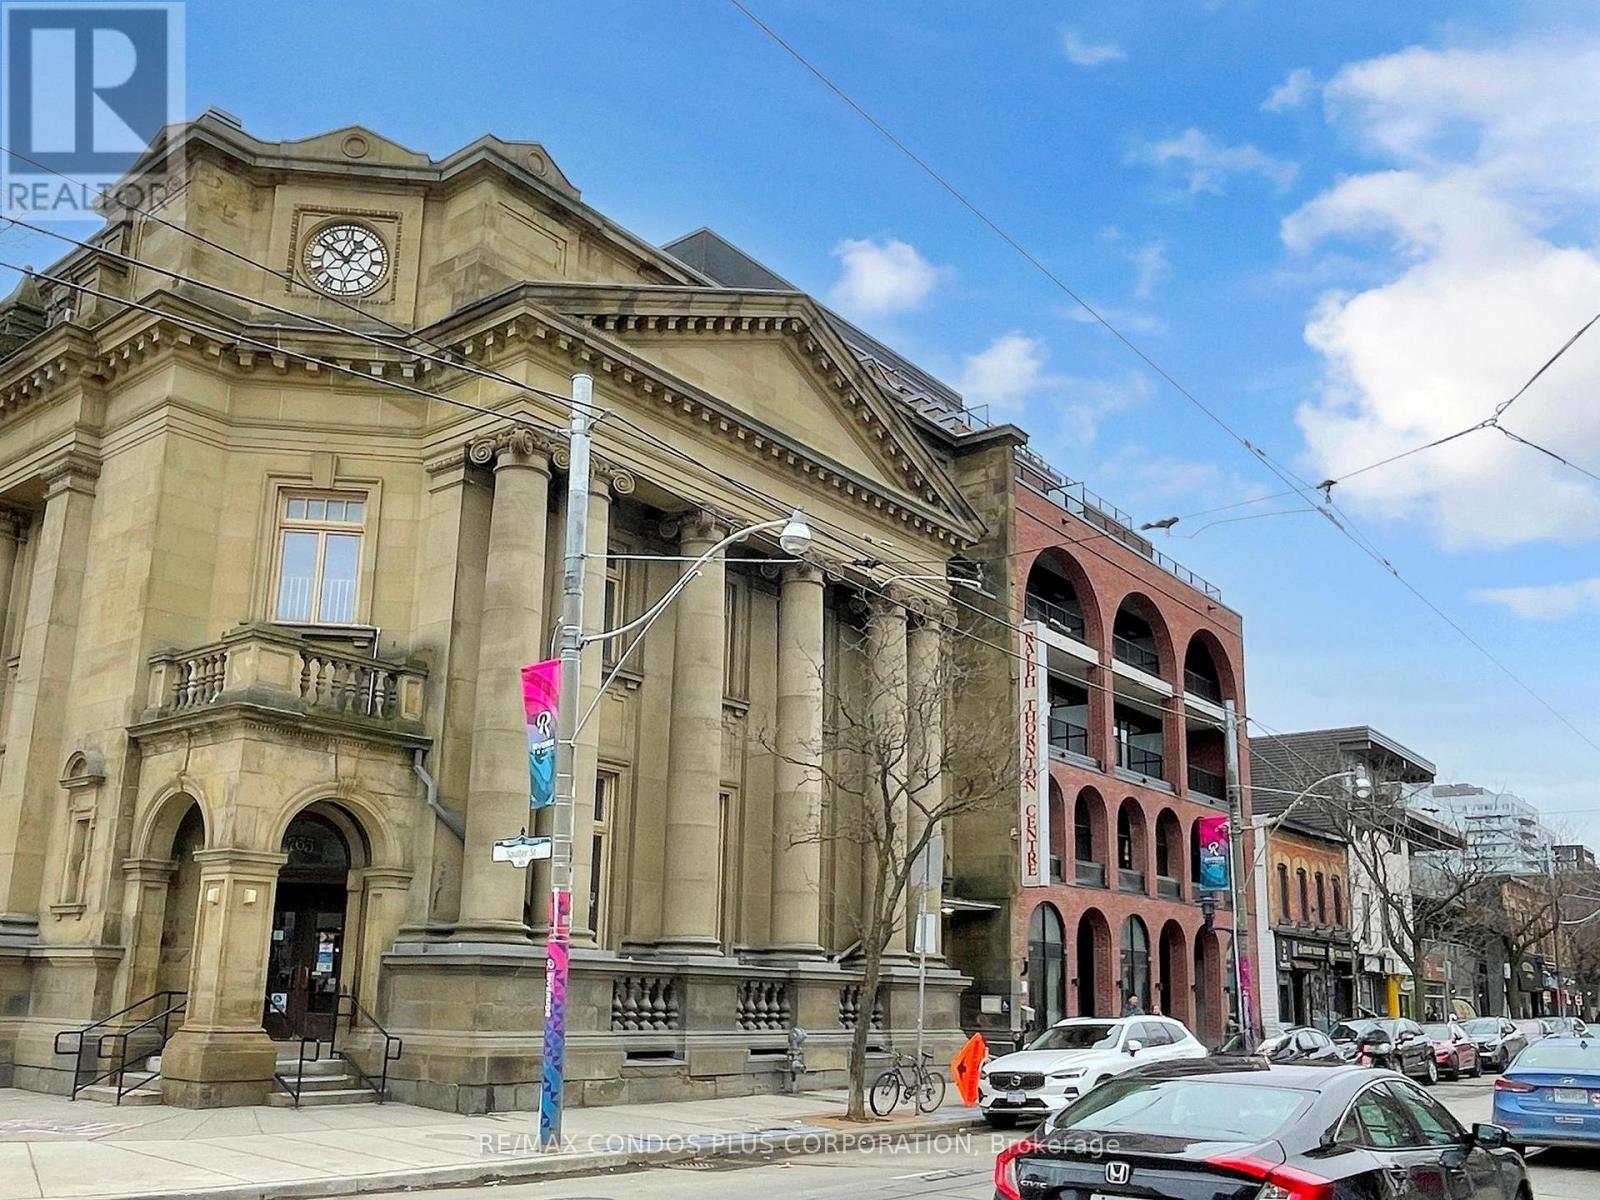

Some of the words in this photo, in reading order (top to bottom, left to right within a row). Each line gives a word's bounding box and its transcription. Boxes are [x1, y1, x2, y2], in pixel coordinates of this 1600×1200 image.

[1025, 631, 1036, 688] RALPH
[1025, 699, 1037, 792] THORNTON
[1026, 804, 1038, 876] CENTRE
[1020, 1179, 1048, 1189] CIVIC
